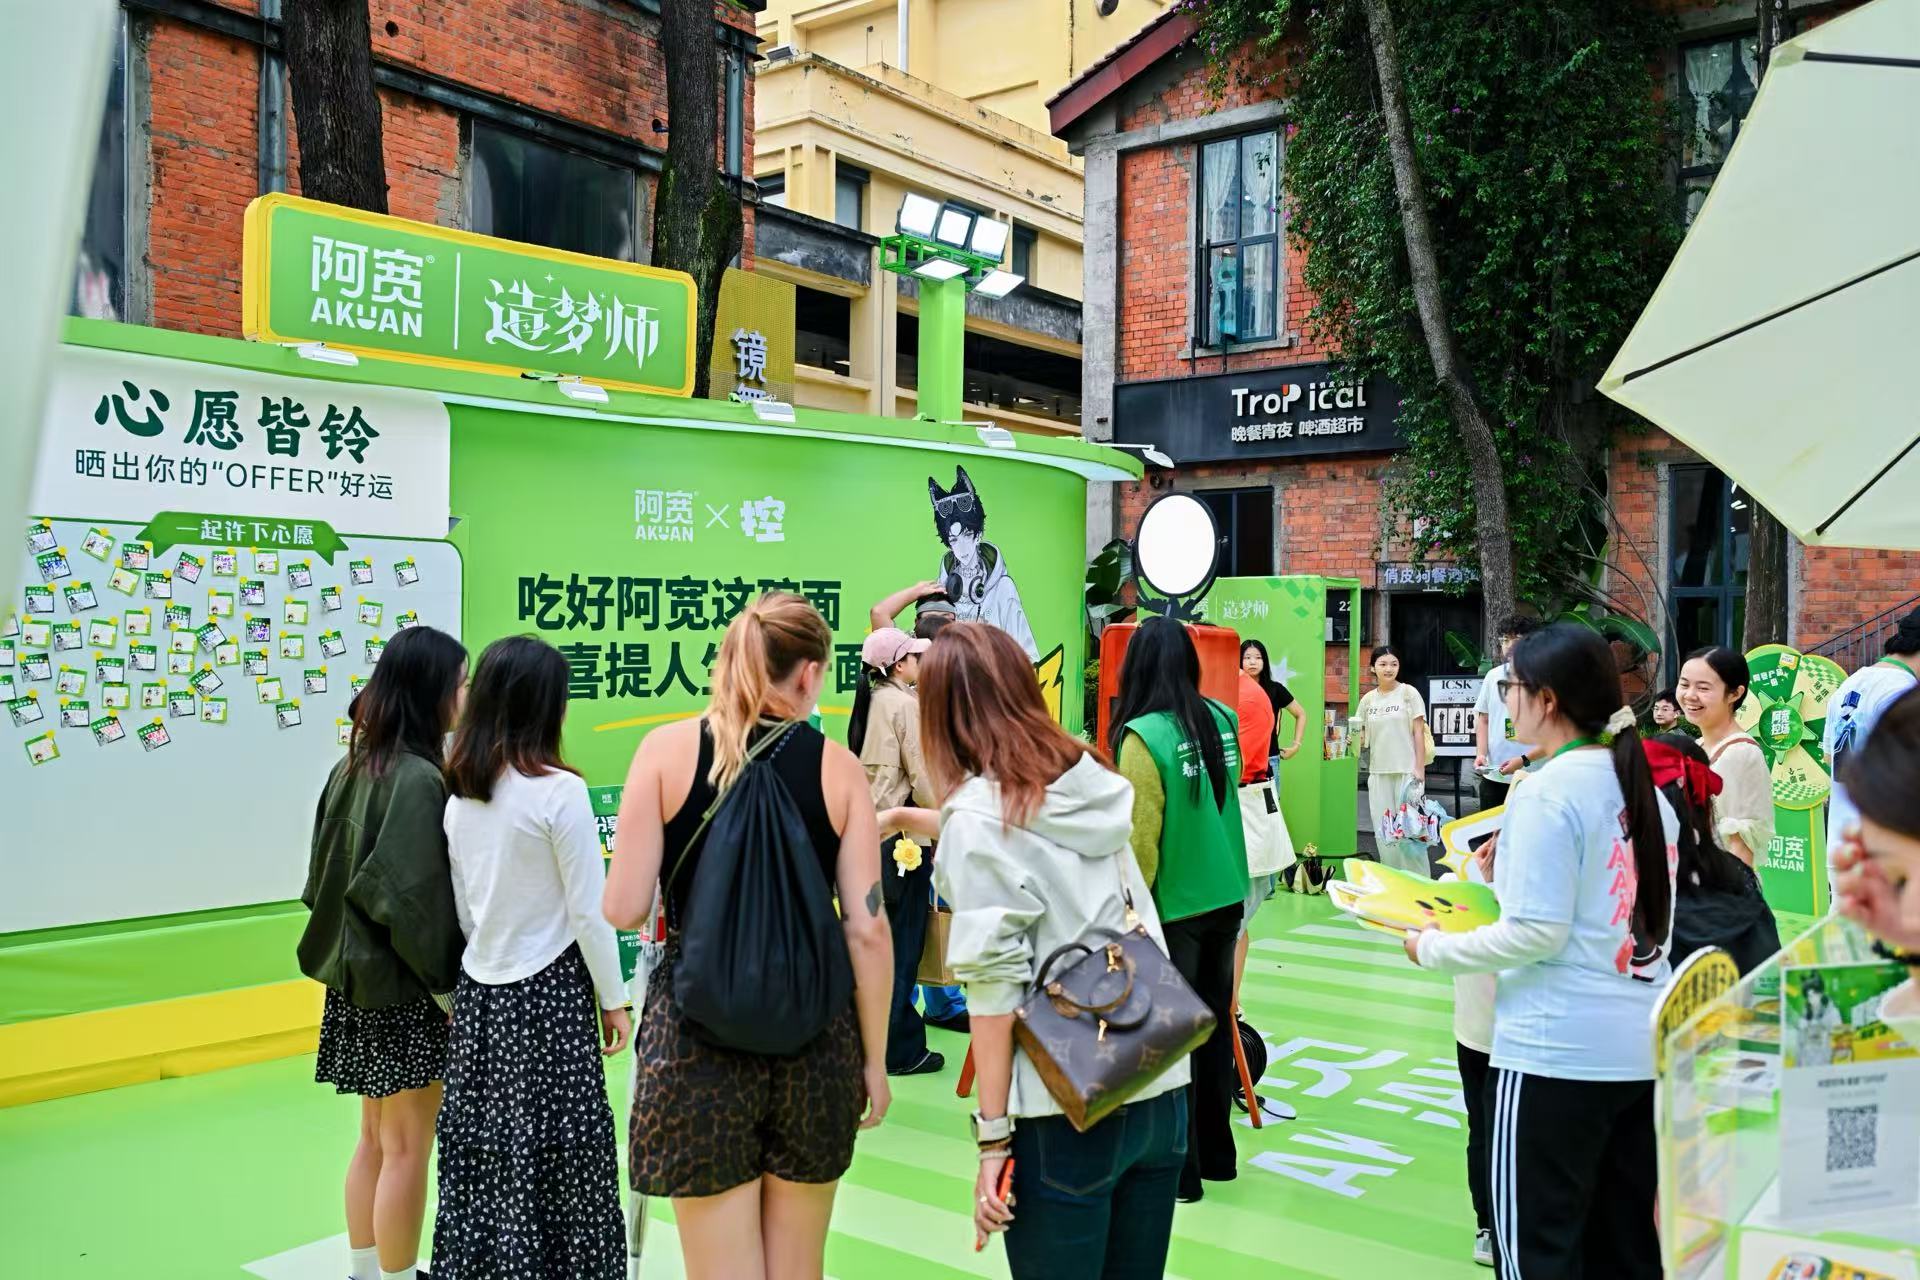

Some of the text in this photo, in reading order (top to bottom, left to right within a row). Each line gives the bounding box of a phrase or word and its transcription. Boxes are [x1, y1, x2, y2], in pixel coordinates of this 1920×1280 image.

[310, 297, 423, 338] AKUAN
[484, 278, 660, 370] 造梦师
[94, 380, 380, 464] 心愿皆铃
[1231, 415, 1364, 442] 晚餐宵夜 啤酒超市
[634, 489, 694, 525] 阿宽
[176, 519, 314, 545] 一起许下心愿
[635, 525, 694, 542] AKUAN
[1765, 858, 1804, 872] AKUAN
